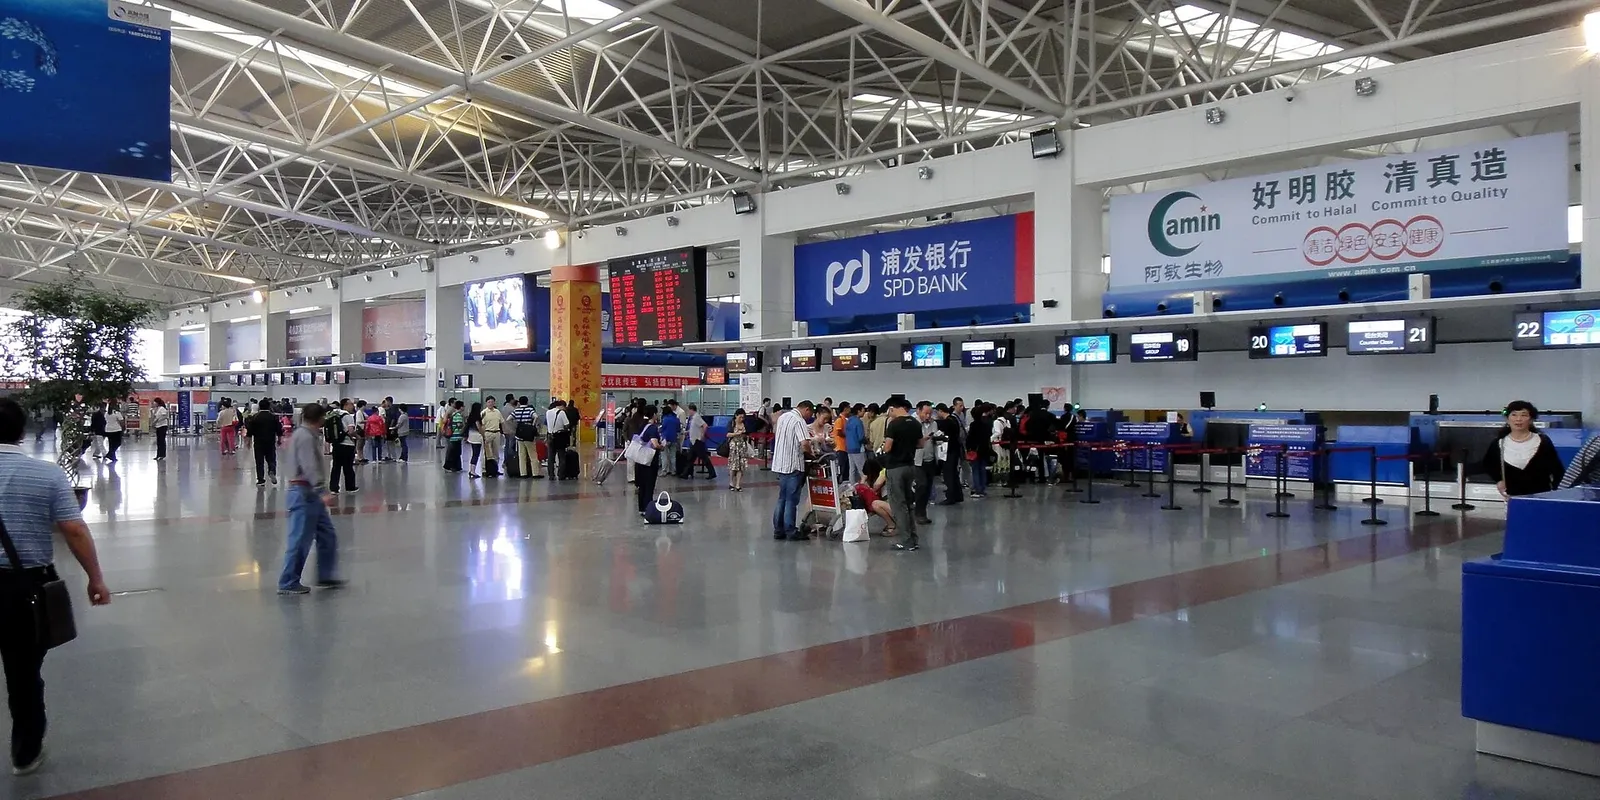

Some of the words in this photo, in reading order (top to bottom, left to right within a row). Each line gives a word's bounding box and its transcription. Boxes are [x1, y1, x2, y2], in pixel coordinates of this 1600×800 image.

[1252, 169, 1356, 210] 好明胶
[1383, 147, 1508, 194] 清真造
[1252, 211, 1301, 225] Commit
[1307, 210, 1320, 219] to
[1324, 204, 1357, 217] Halal
[1371, 196, 1428, 211] Commit
[1432, 195, 1447, 204] to
[1451, 187, 1508, 202] Quality
[1308, 238, 1333, 254] 清洁
[1340, 235, 1367, 251] 绿色
[1374, 232, 1402, 248] 安全
[1409, 227, 1439, 245] 健康
[881, 240, 972, 276] 浦发银行
[1144, 260, 1224, 283] 阿敏生物
[883, 278, 915, 298] SPD
[918, 271, 968, 295] BANK
[1409, 327, 1426, 342] 21
[1517, 322, 1540, 338] 22
[1176, 338, 1189, 352] 19
[1252, 335, 1268, 349] 20
[903, 351, 912, 361] 16
[996, 347, 1006, 358] 17
[1058, 344, 1069, 356] 18
[748, 357, 756, 366] 13
[782, 356, 790, 366] 14
[860, 352, 868, 363] 15
